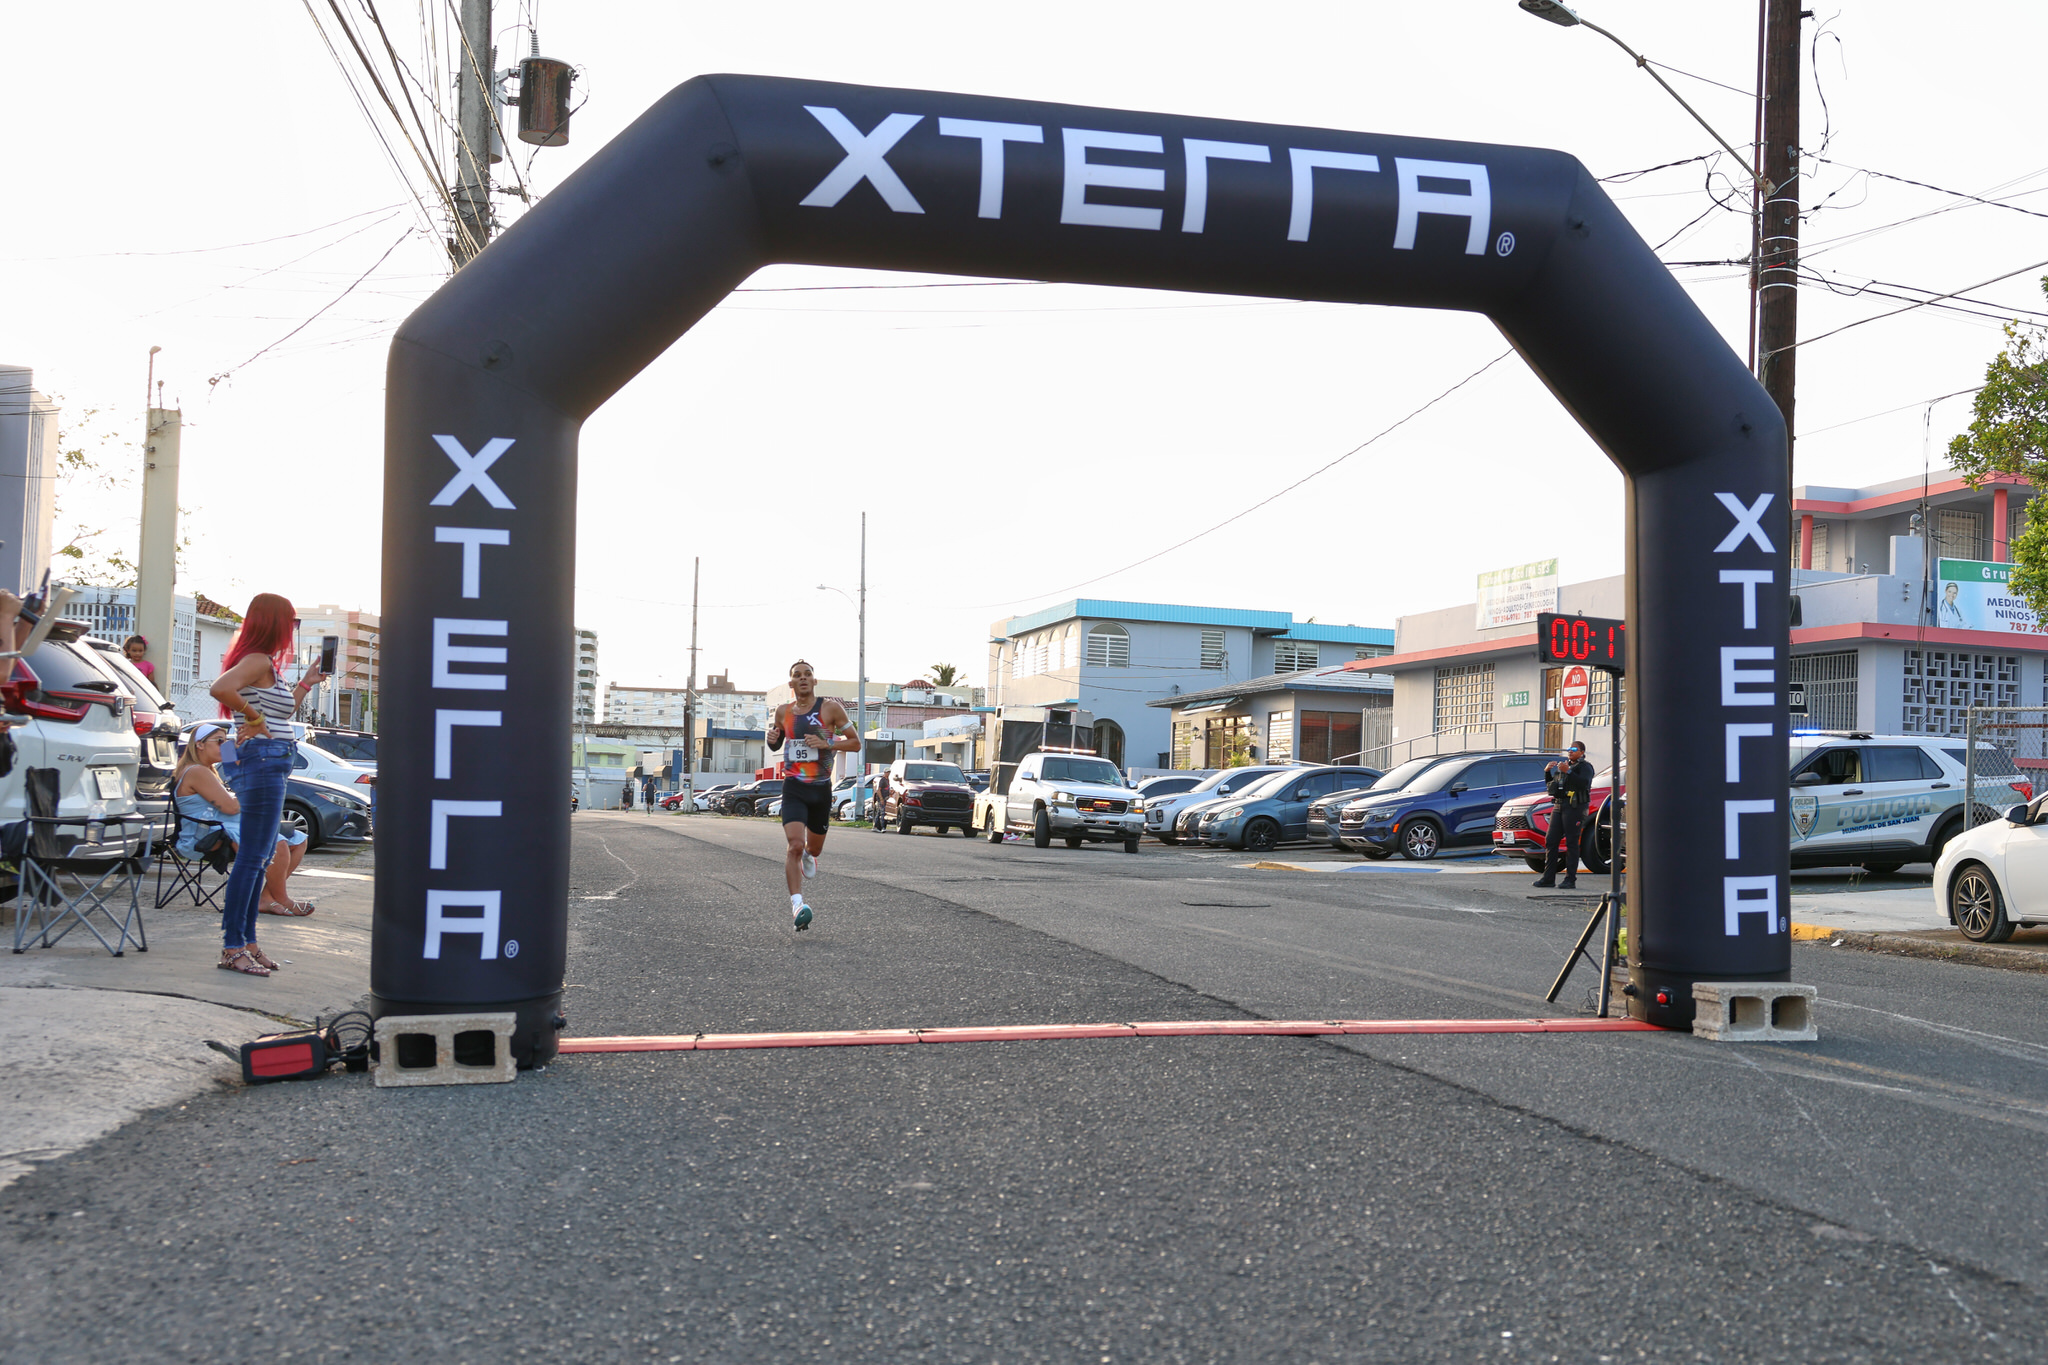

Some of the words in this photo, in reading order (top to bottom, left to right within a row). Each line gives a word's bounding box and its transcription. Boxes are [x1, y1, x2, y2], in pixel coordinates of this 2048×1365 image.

[2010, 622, 2028, 632] 787
[1551, 618, 1625, 659] 00:1
[1571, 674, 1580, 684] NO
[1515, 692, 1528, 705] 513
[1566, 698, 1582, 707] ENTRE
[796, 749, 808, 759] 95
[1837, 794, 1932, 826] POLICIA
[1842, 823, 1877, 835] MUNICIPAL
[1878, 820, 1886, 828] DE
[1887, 818, 1901, 827] SAN
[1902, 815, 1920, 824] JUAN
